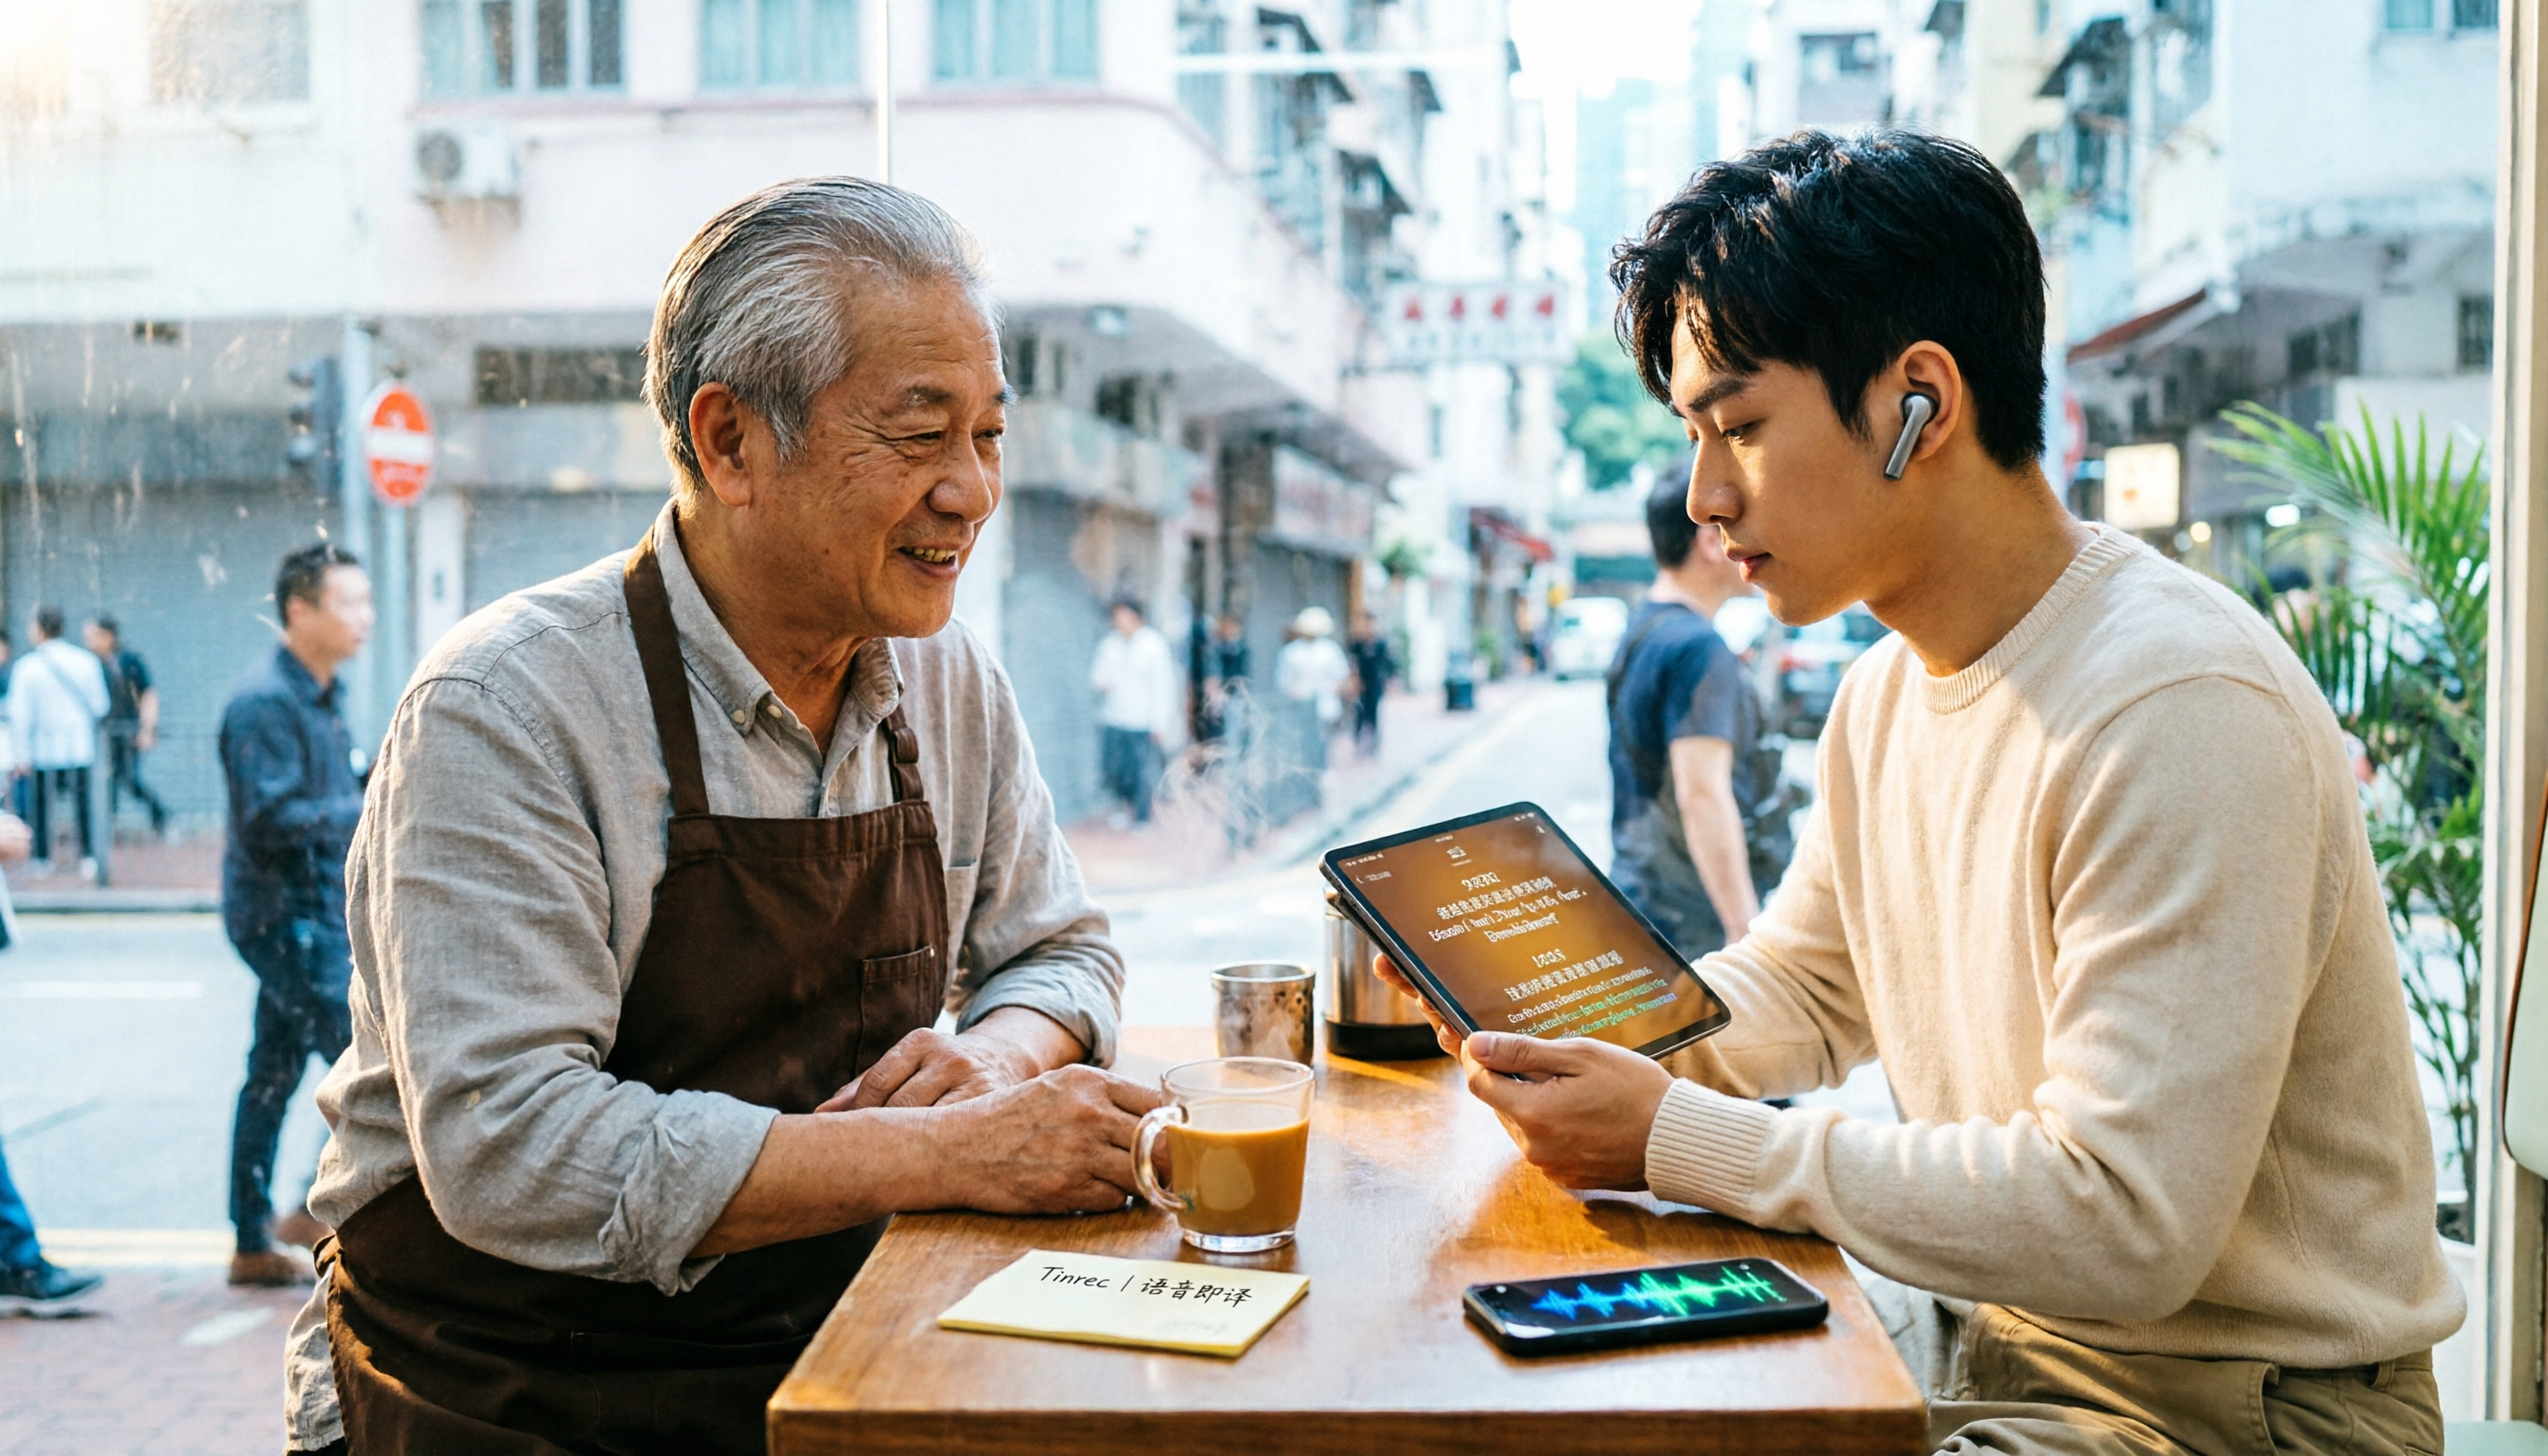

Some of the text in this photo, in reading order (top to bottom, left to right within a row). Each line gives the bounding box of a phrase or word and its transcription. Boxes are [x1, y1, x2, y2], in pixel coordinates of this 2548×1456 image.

[1041, 1266, 1110, 1288] Tinrec
[1140, 1278, 1252, 1308] 语音即译
